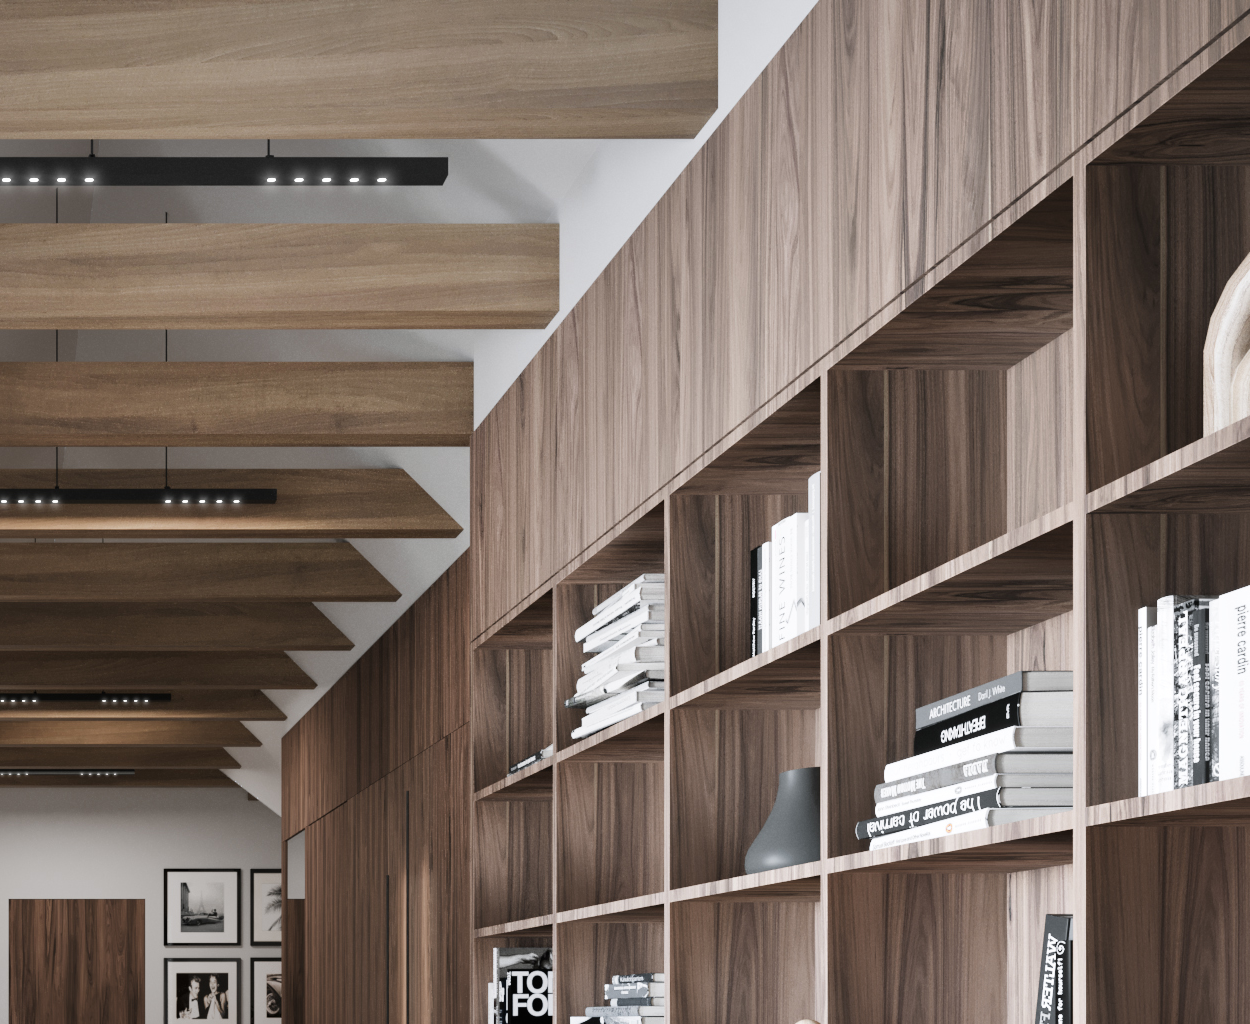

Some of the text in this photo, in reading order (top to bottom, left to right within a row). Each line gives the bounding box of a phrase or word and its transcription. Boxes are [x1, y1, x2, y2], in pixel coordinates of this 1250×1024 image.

[1235, 604, 1248, 675] pierre cardin
[929, 695, 971, 720] ARCHITECTURE
[909, 811, 919, 828] of
[923, 797, 959, 820] power
[867, 814, 905, 837] carnival
